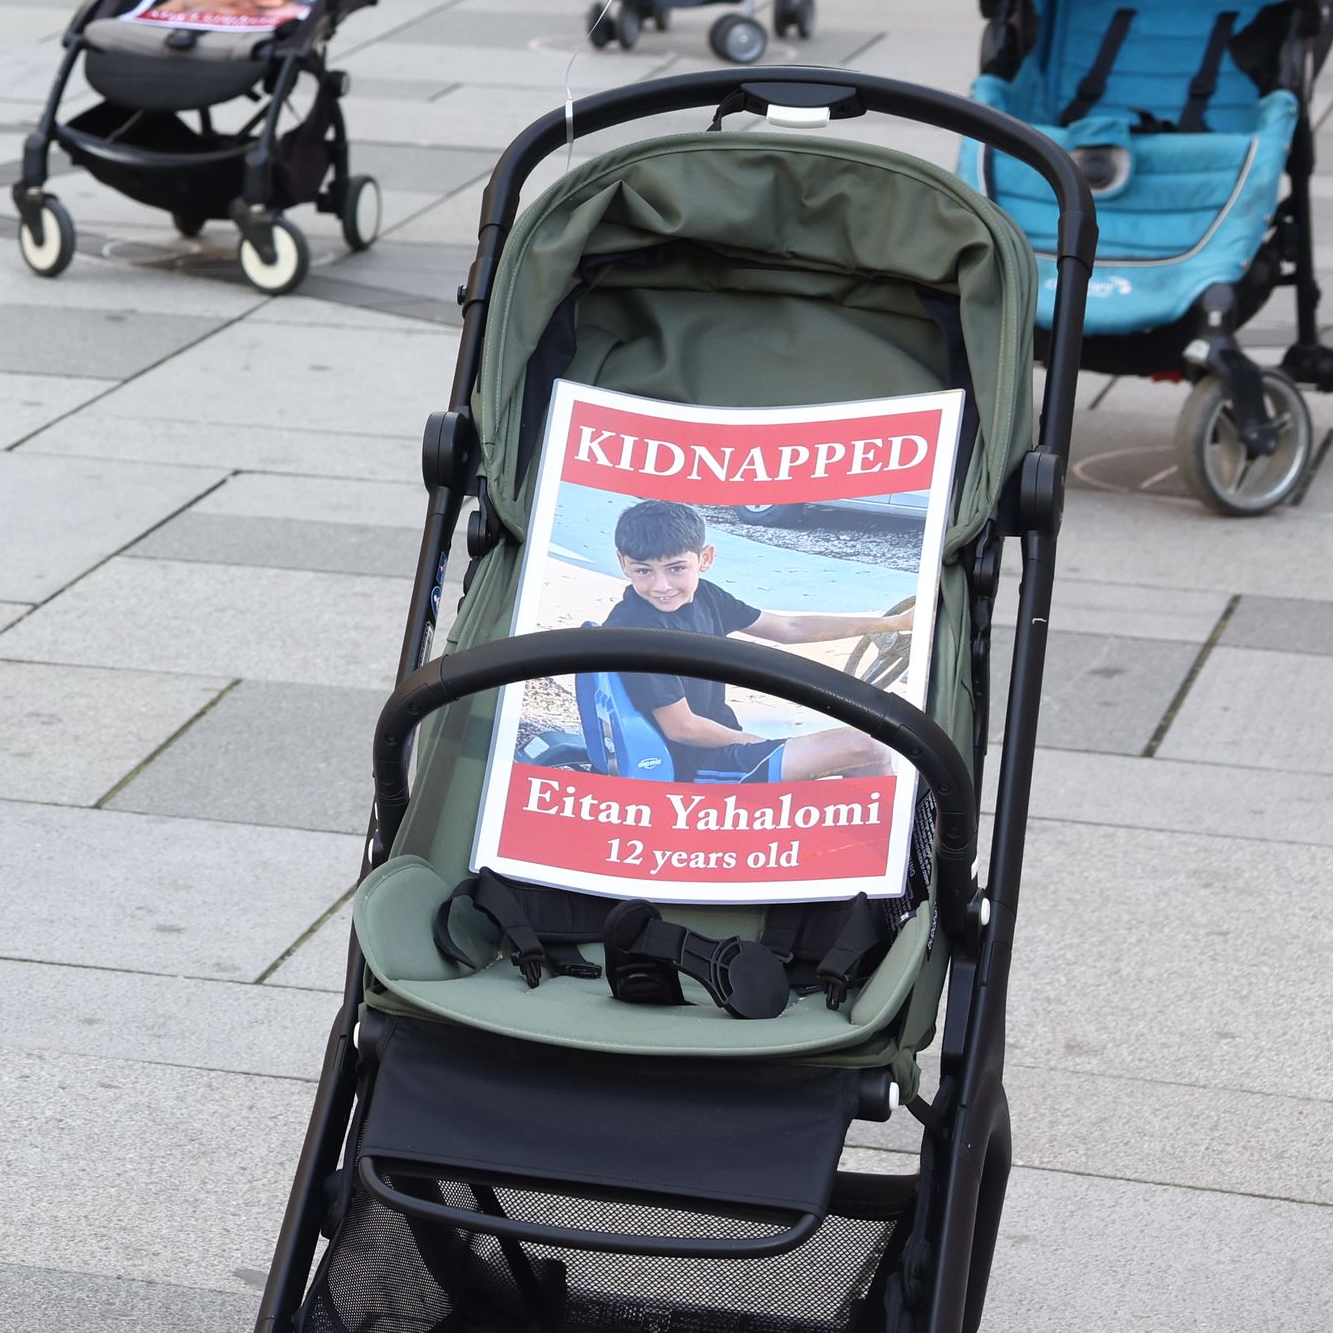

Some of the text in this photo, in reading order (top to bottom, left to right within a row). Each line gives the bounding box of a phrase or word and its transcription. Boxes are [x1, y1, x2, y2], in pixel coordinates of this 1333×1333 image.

[573, 424, 929, 483] KIDNAPPED
[522, 776, 882, 832] Eitan Yahalomi
[605, 839, 800, 875] 12 years old
